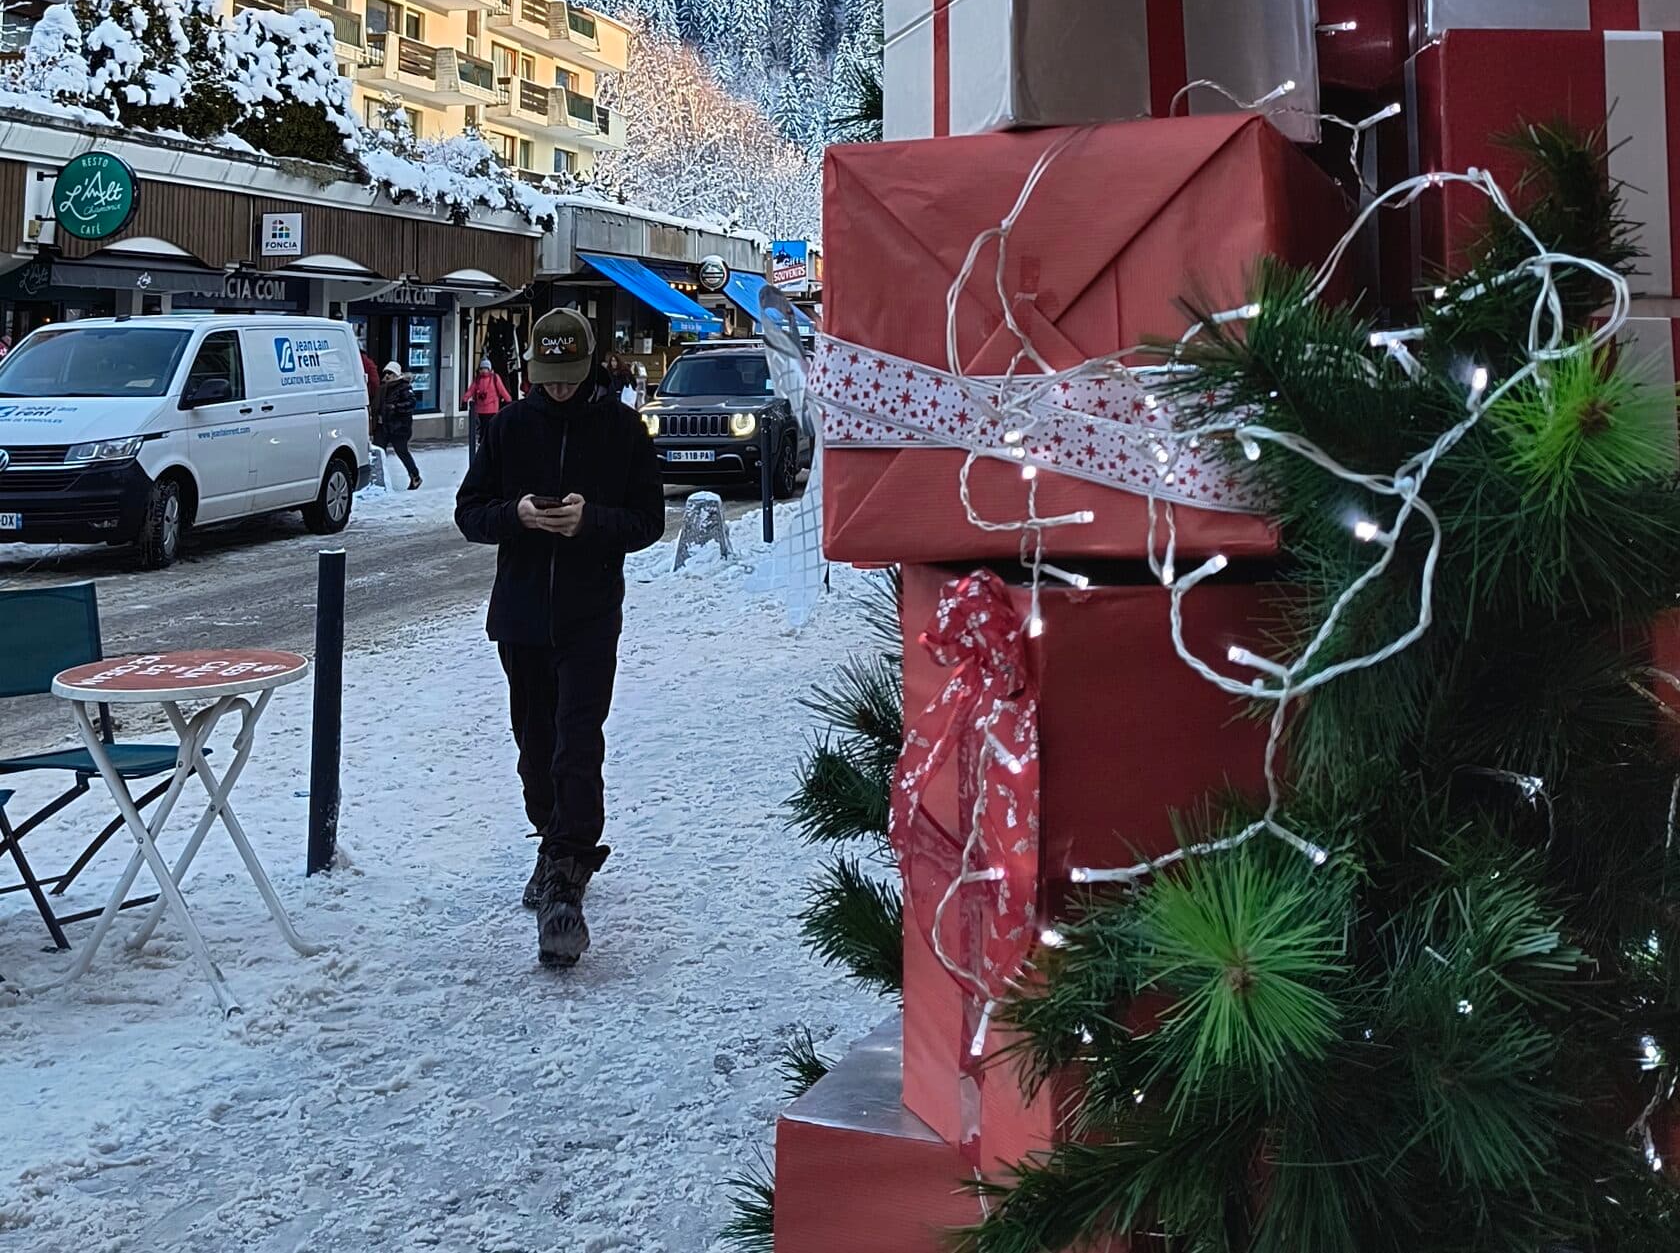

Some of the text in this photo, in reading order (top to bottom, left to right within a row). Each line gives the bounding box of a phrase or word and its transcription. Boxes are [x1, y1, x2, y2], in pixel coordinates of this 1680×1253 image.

[81, 156, 109, 168] RESTO
[265, 241, 298, 249] FONCIA
[297, 352, 320, 368] rent
